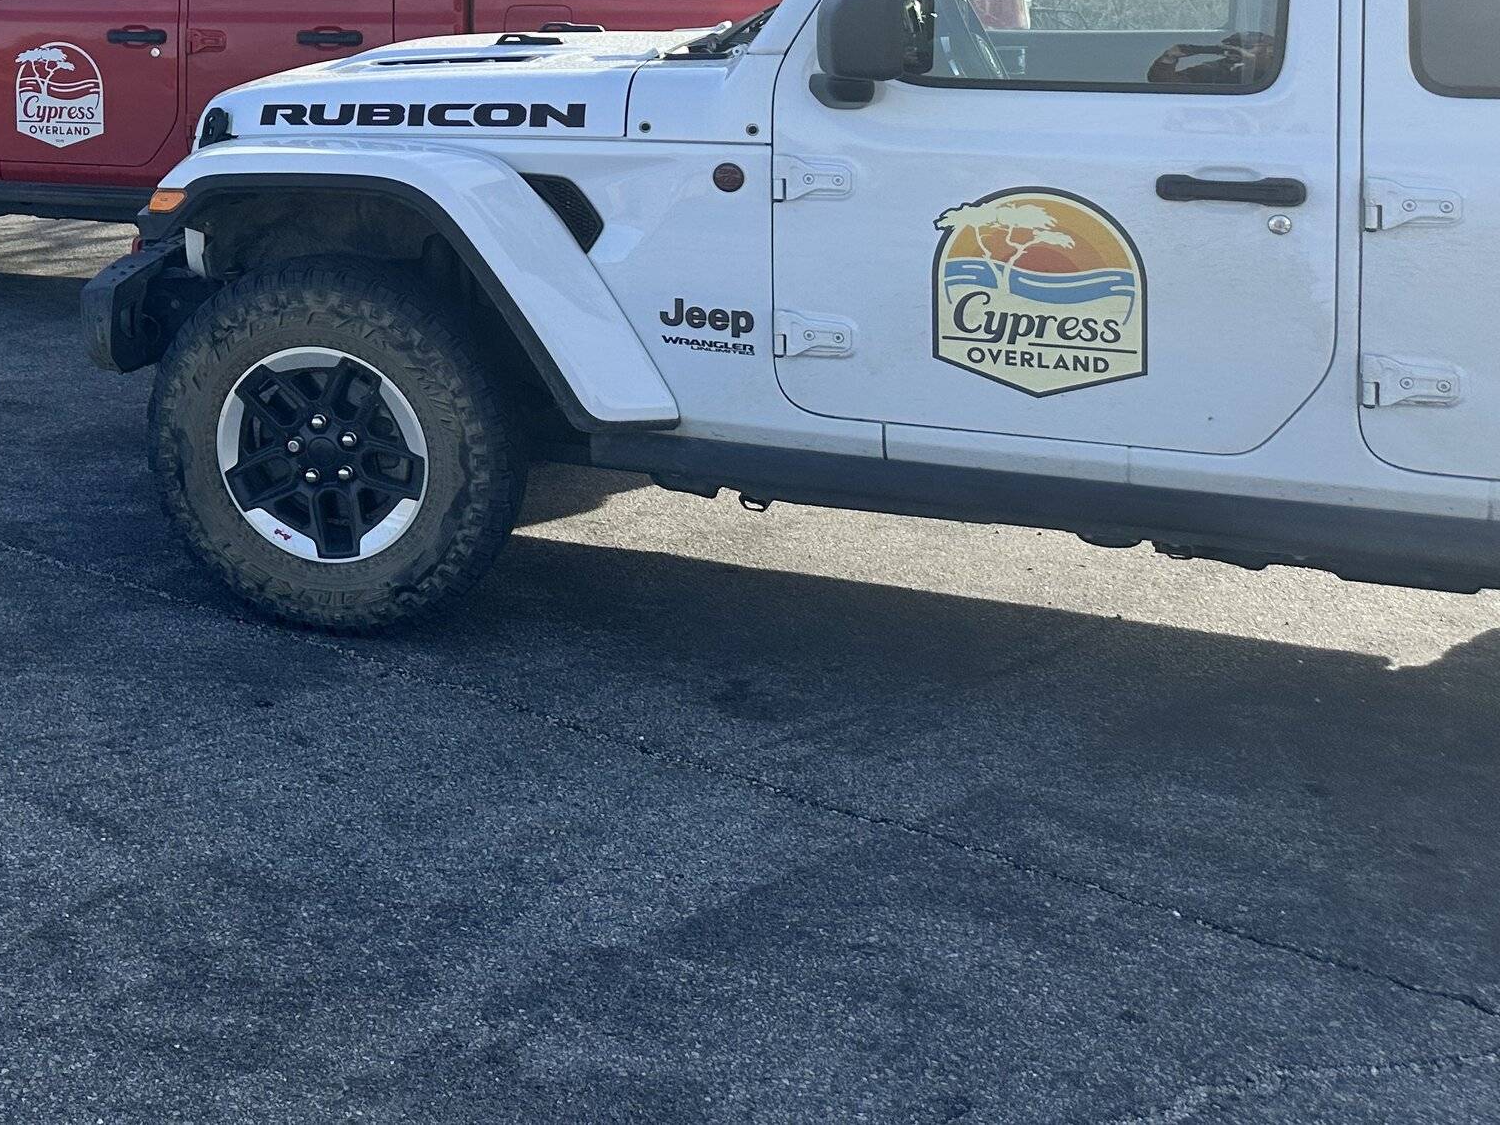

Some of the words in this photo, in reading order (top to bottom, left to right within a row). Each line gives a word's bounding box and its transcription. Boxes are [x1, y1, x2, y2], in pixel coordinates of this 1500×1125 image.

[22, 95, 95, 124] Cypress
[259, 103, 587, 128] RUBICON
[29, 125, 91, 136] OVERLAND
[659, 297, 755, 339] Jeep
[952, 290, 1122, 345] Cypress
[661, 334, 755, 352] WRANGLER
[690, 345, 756, 356] UNLIMITED
[966, 346, 1110, 374] OVERLAND
